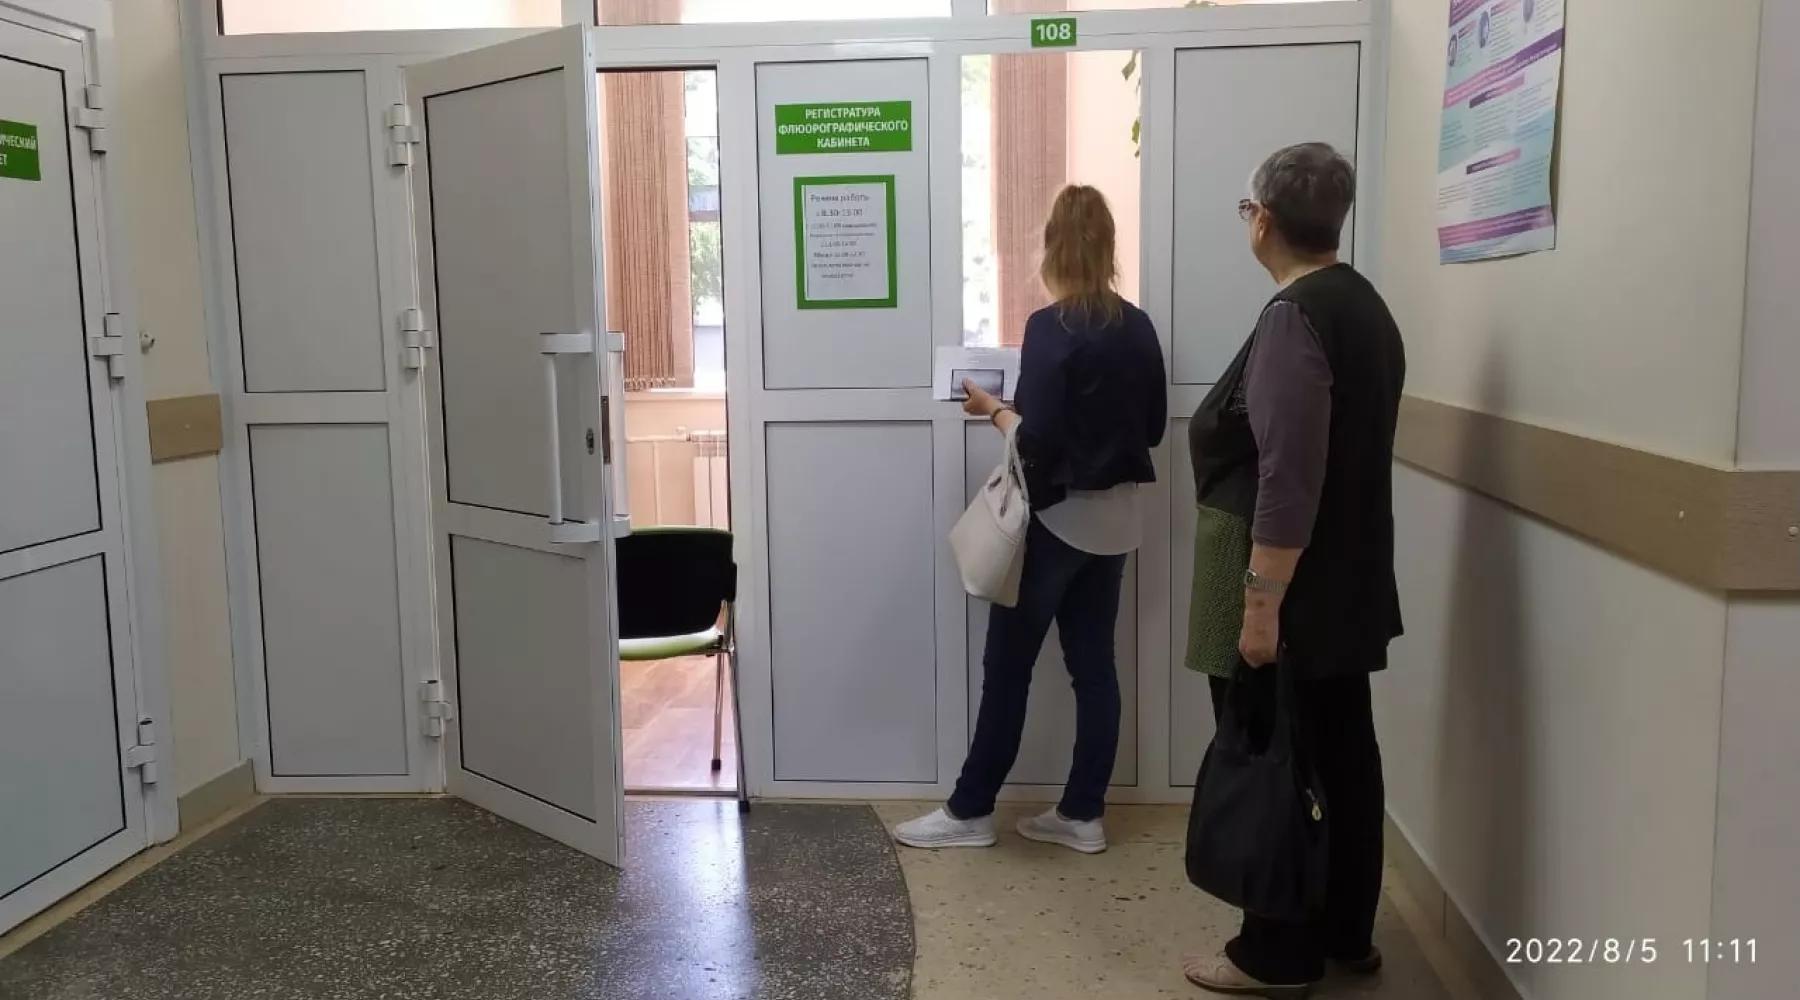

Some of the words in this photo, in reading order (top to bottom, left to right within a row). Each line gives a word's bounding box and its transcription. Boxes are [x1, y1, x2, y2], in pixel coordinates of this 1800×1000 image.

[1036, 23, 1071, 41] 108
[805, 107, 881, 119] РЕГИСТРАТУРА
[779, 120, 908, 135] ФЛЮОРОГРАФИЧЕСКОГО
[816, 137, 870, 148] КАБИНЕТА
